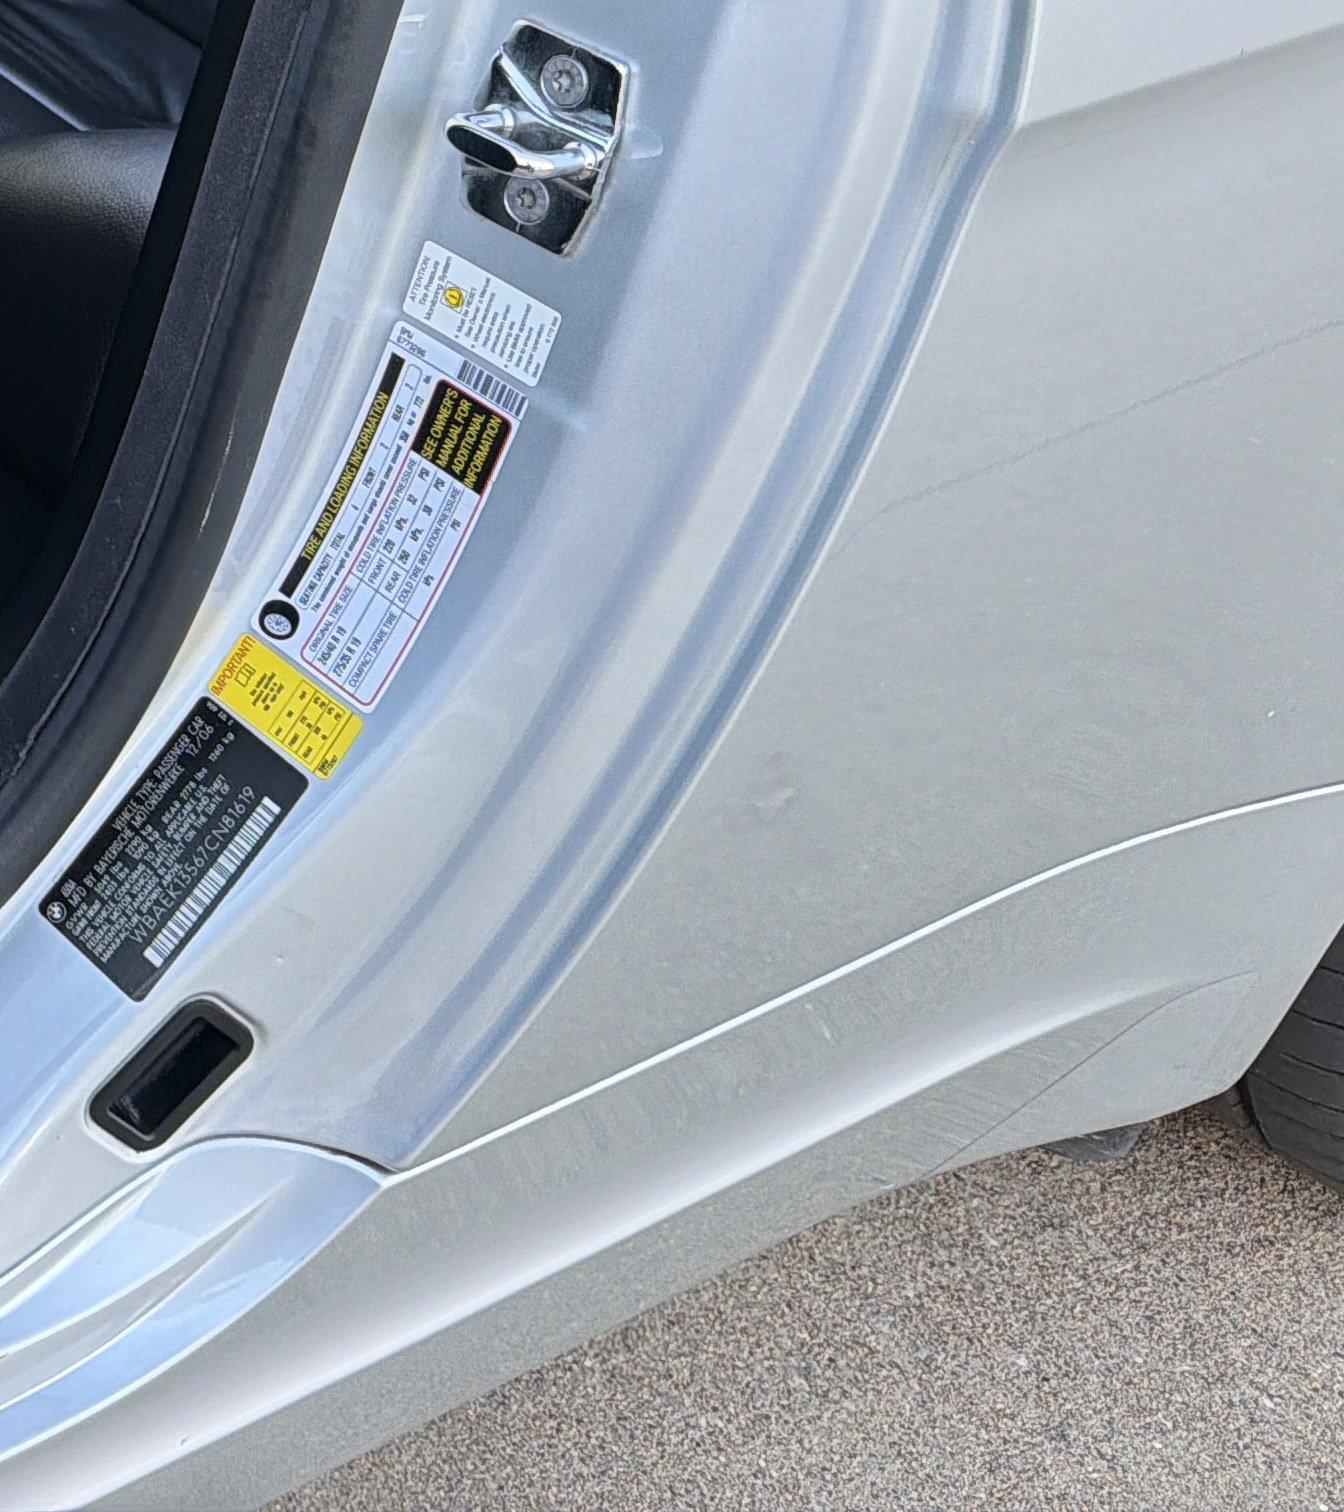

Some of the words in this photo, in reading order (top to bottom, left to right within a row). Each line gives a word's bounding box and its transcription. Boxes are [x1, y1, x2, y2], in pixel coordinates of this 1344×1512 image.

[418, 292, 429, 305] Tire
[424, 260, 440, 292] Pressure
[424, 283, 444, 321] Monitoring
[438, 256, 452, 283] System
[301, 534, 322, 560] TIRE
[315, 512, 333, 537] AND
[327, 465, 356, 513] LOADING
[349, 392, 388, 467] INFORMATION
[421, 436, 438, 460] SEE
[430, 388, 458, 438] OWNER'S
[436, 424, 463, 467] MANUAL
[454, 399, 472, 424] FOR
[451, 413, 486, 475] ADDITIONAL
[463, 415, 502, 488] INFORMATION
[313, 553, 333, 581] CAPACITY
[330, 532, 345, 550] TOTAL
[362, 467, 376, 488] FRONT
[391, 405, 404, 422] REAR
[356, 551, 371, 573] COLD
[367, 534, 380, 552] TIRE
[376, 497, 399, 536] INFLATION
[394, 458, 417, 498] PRESSURE
[368, 557, 386, 584] FRONT
[418, 467, 430, 481] PSI
[385, 571, 401, 593] REAR
[433, 477, 445, 492] PSI
[398, 581, 413, 603] COLD
[409, 564, 423, 582] TIRE
[417, 526, 442, 566] INFLATION
[437, 486, 461, 528] PRESSURE
[450, 519, 461, 531] PSI
[211, 635, 256, 696] IMPORTANT!
[309, 620, 334, 652] ORIGINAL
[329, 602, 343, 619] TIRE
[339, 585, 353, 603] SIZE
[331, 635, 340, 643] R
[346, 646, 356, 655] R
[349, 651, 373, 688] COMPACT
[369, 628, 388, 653] SPARE
[383, 611, 397, 629] TIRE
[83, 872, 97, 888] BY
[93, 826, 135, 875] BAYERISCHE
[131, 762, 185, 829] MOTORENWERKE
[185, 724, 214, 756] 12/06
[112, 799, 141, 831] VEHICLE
[153, 734, 191, 779] PASSENGER
[187, 716, 204, 735] CAR
[116, 867, 130, 881] lbs
[132, 842, 149, 860] 1090
[147, 829, 160, 842] kg
[161, 800, 181, 824] REAR
[194, 767, 208, 781] lbs
[208, 744, 224, 762] 1260
[221, 732, 234, 744] kg
[66, 902, 88, 929] GVWR
[109, 861, 123, 875] lbs
[140, 824, 153, 836] kg
[79, 927, 94, 943] THIS
[92, 900, 116, 927] VEHICLE
[114, 863, 146, 901] CONFORMS
[144, 851, 155, 862] TO
[154, 837, 166, 852] ALL
[165, 797, 197, 838] APPLICABLE
[86, 921, 111, 950] FEDERAL
[109, 895, 132, 921] MOTOR
[130, 868, 154, 894] VEHICLE
[173, 813, 196, 841] BUMPER
[196, 796, 209, 813] AND
[207, 774, 225, 795] THEFT
[93, 915, 128, 957] PREVENTION
[125, 875, 159, 916] STANDARDS
[157, 866, 167, 875] IN
[164, 841, 185, 867] EFFECT
[184, 828, 197, 842] ON
[193, 814, 208, 828] THE
[205, 794, 223, 815] DATE
[220, 783, 230, 795] OF
[129, 786, 255, 943] WBAEK13567CN81619
[100, 912, 142, 963] MANUFACTURE
[140, 885, 163, 913] SHOWN
